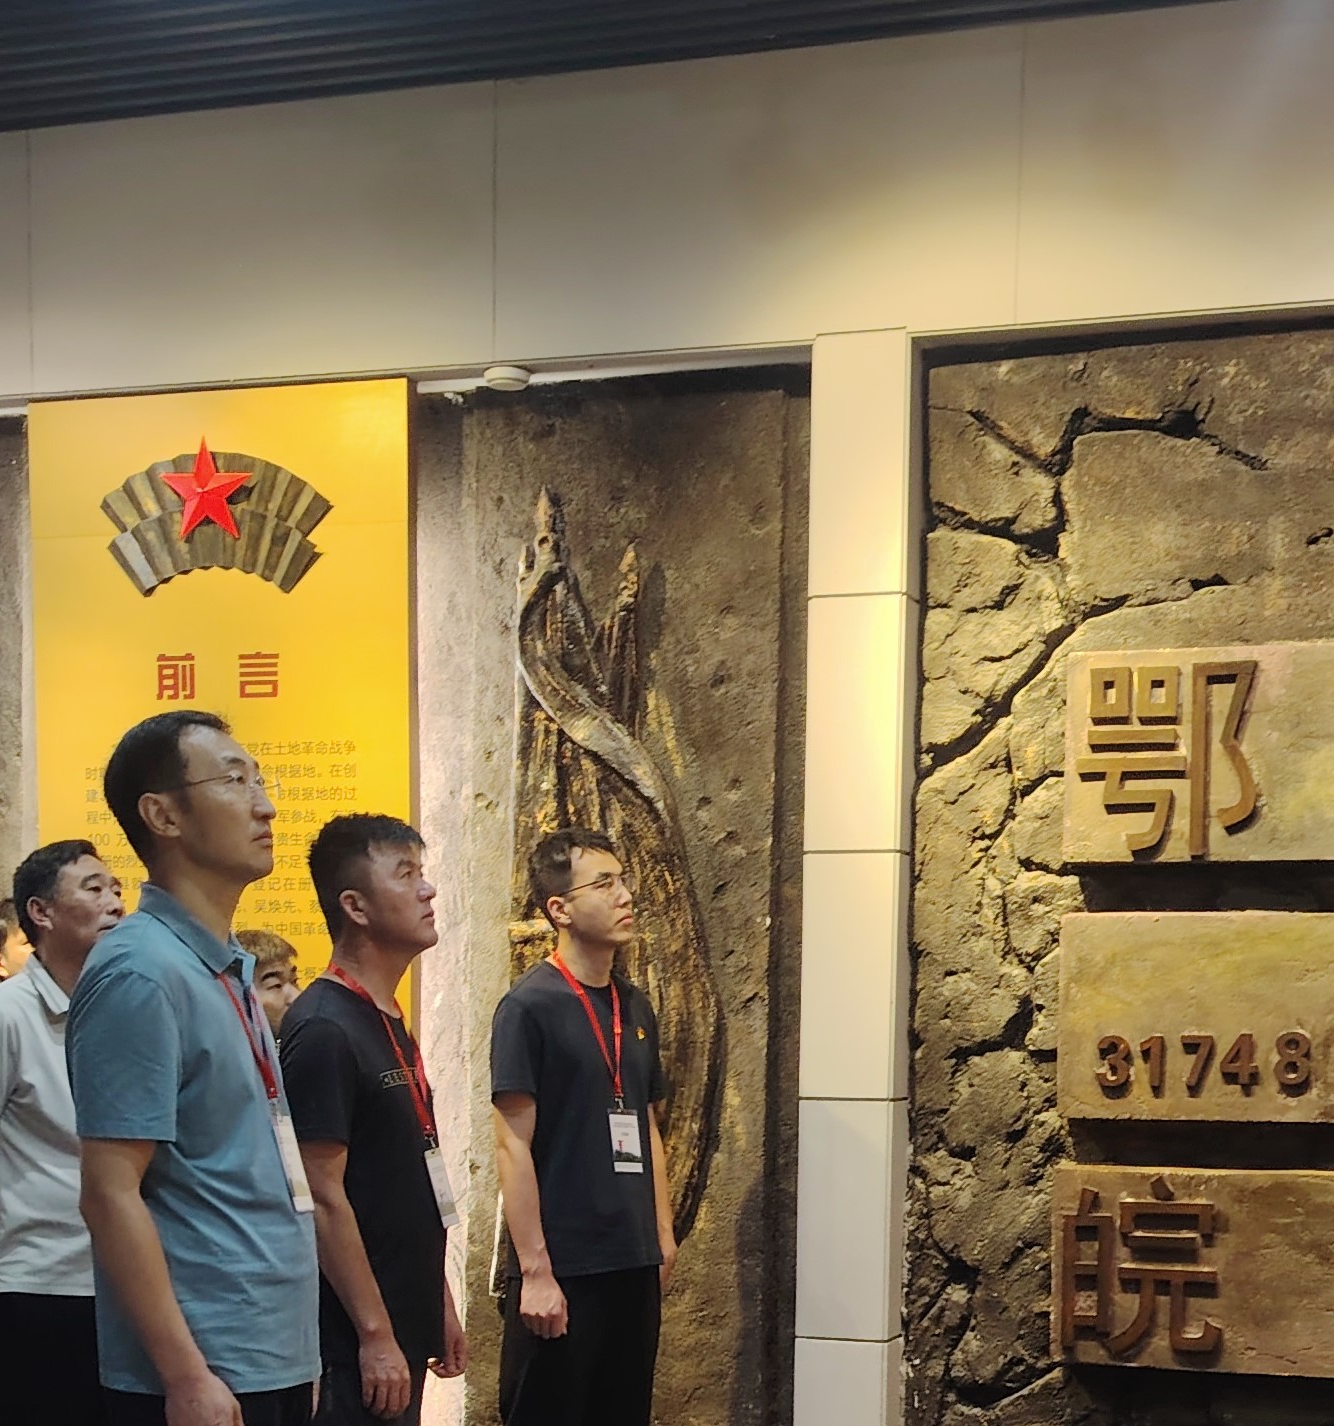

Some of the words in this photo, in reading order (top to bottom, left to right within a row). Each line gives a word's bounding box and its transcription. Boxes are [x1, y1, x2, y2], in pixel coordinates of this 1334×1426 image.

[156, 652, 279, 700] 前言
[240, 740, 356, 756] 党在土地革命战争
[1076, 660, 1260, 858] 鄂
[1096, 1031, 1313, 1096] 31748
[1065, 1177, 1224, 1360] 皖
